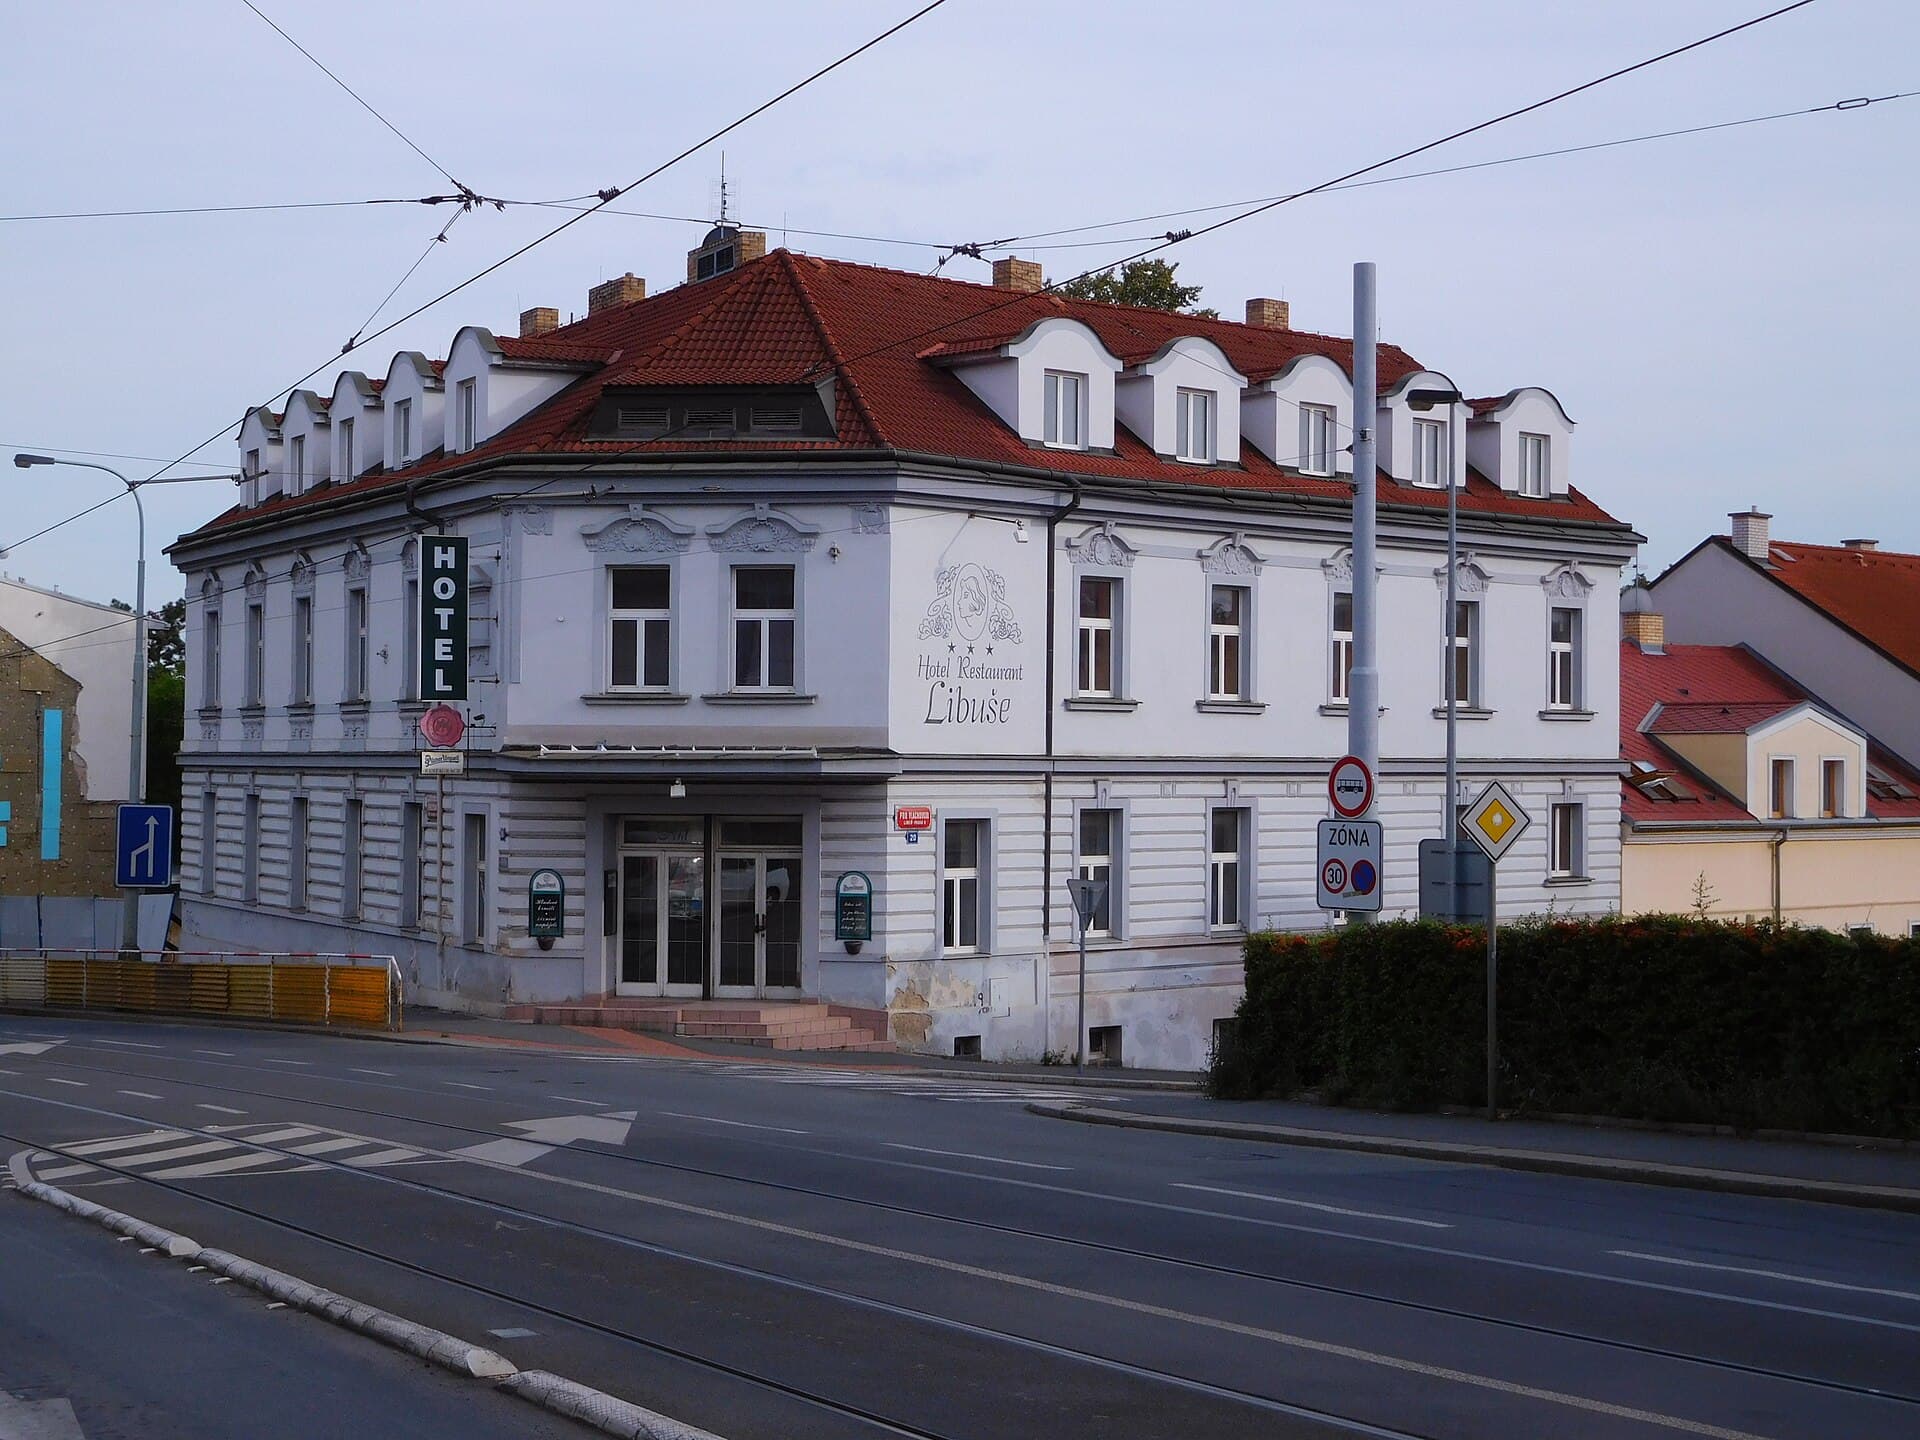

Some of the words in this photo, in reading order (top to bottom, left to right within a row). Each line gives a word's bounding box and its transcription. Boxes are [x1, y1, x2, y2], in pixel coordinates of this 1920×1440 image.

[433, 546, 456, 691] HOTEL
[918, 654, 950, 680] Hotel
[957, 655, 1024, 680] Restaurant
[923, 680, 1011, 724] Libuše
[1328, 824, 1370, 847] ZÓNA
[1327, 868, 1342, 884] 30
